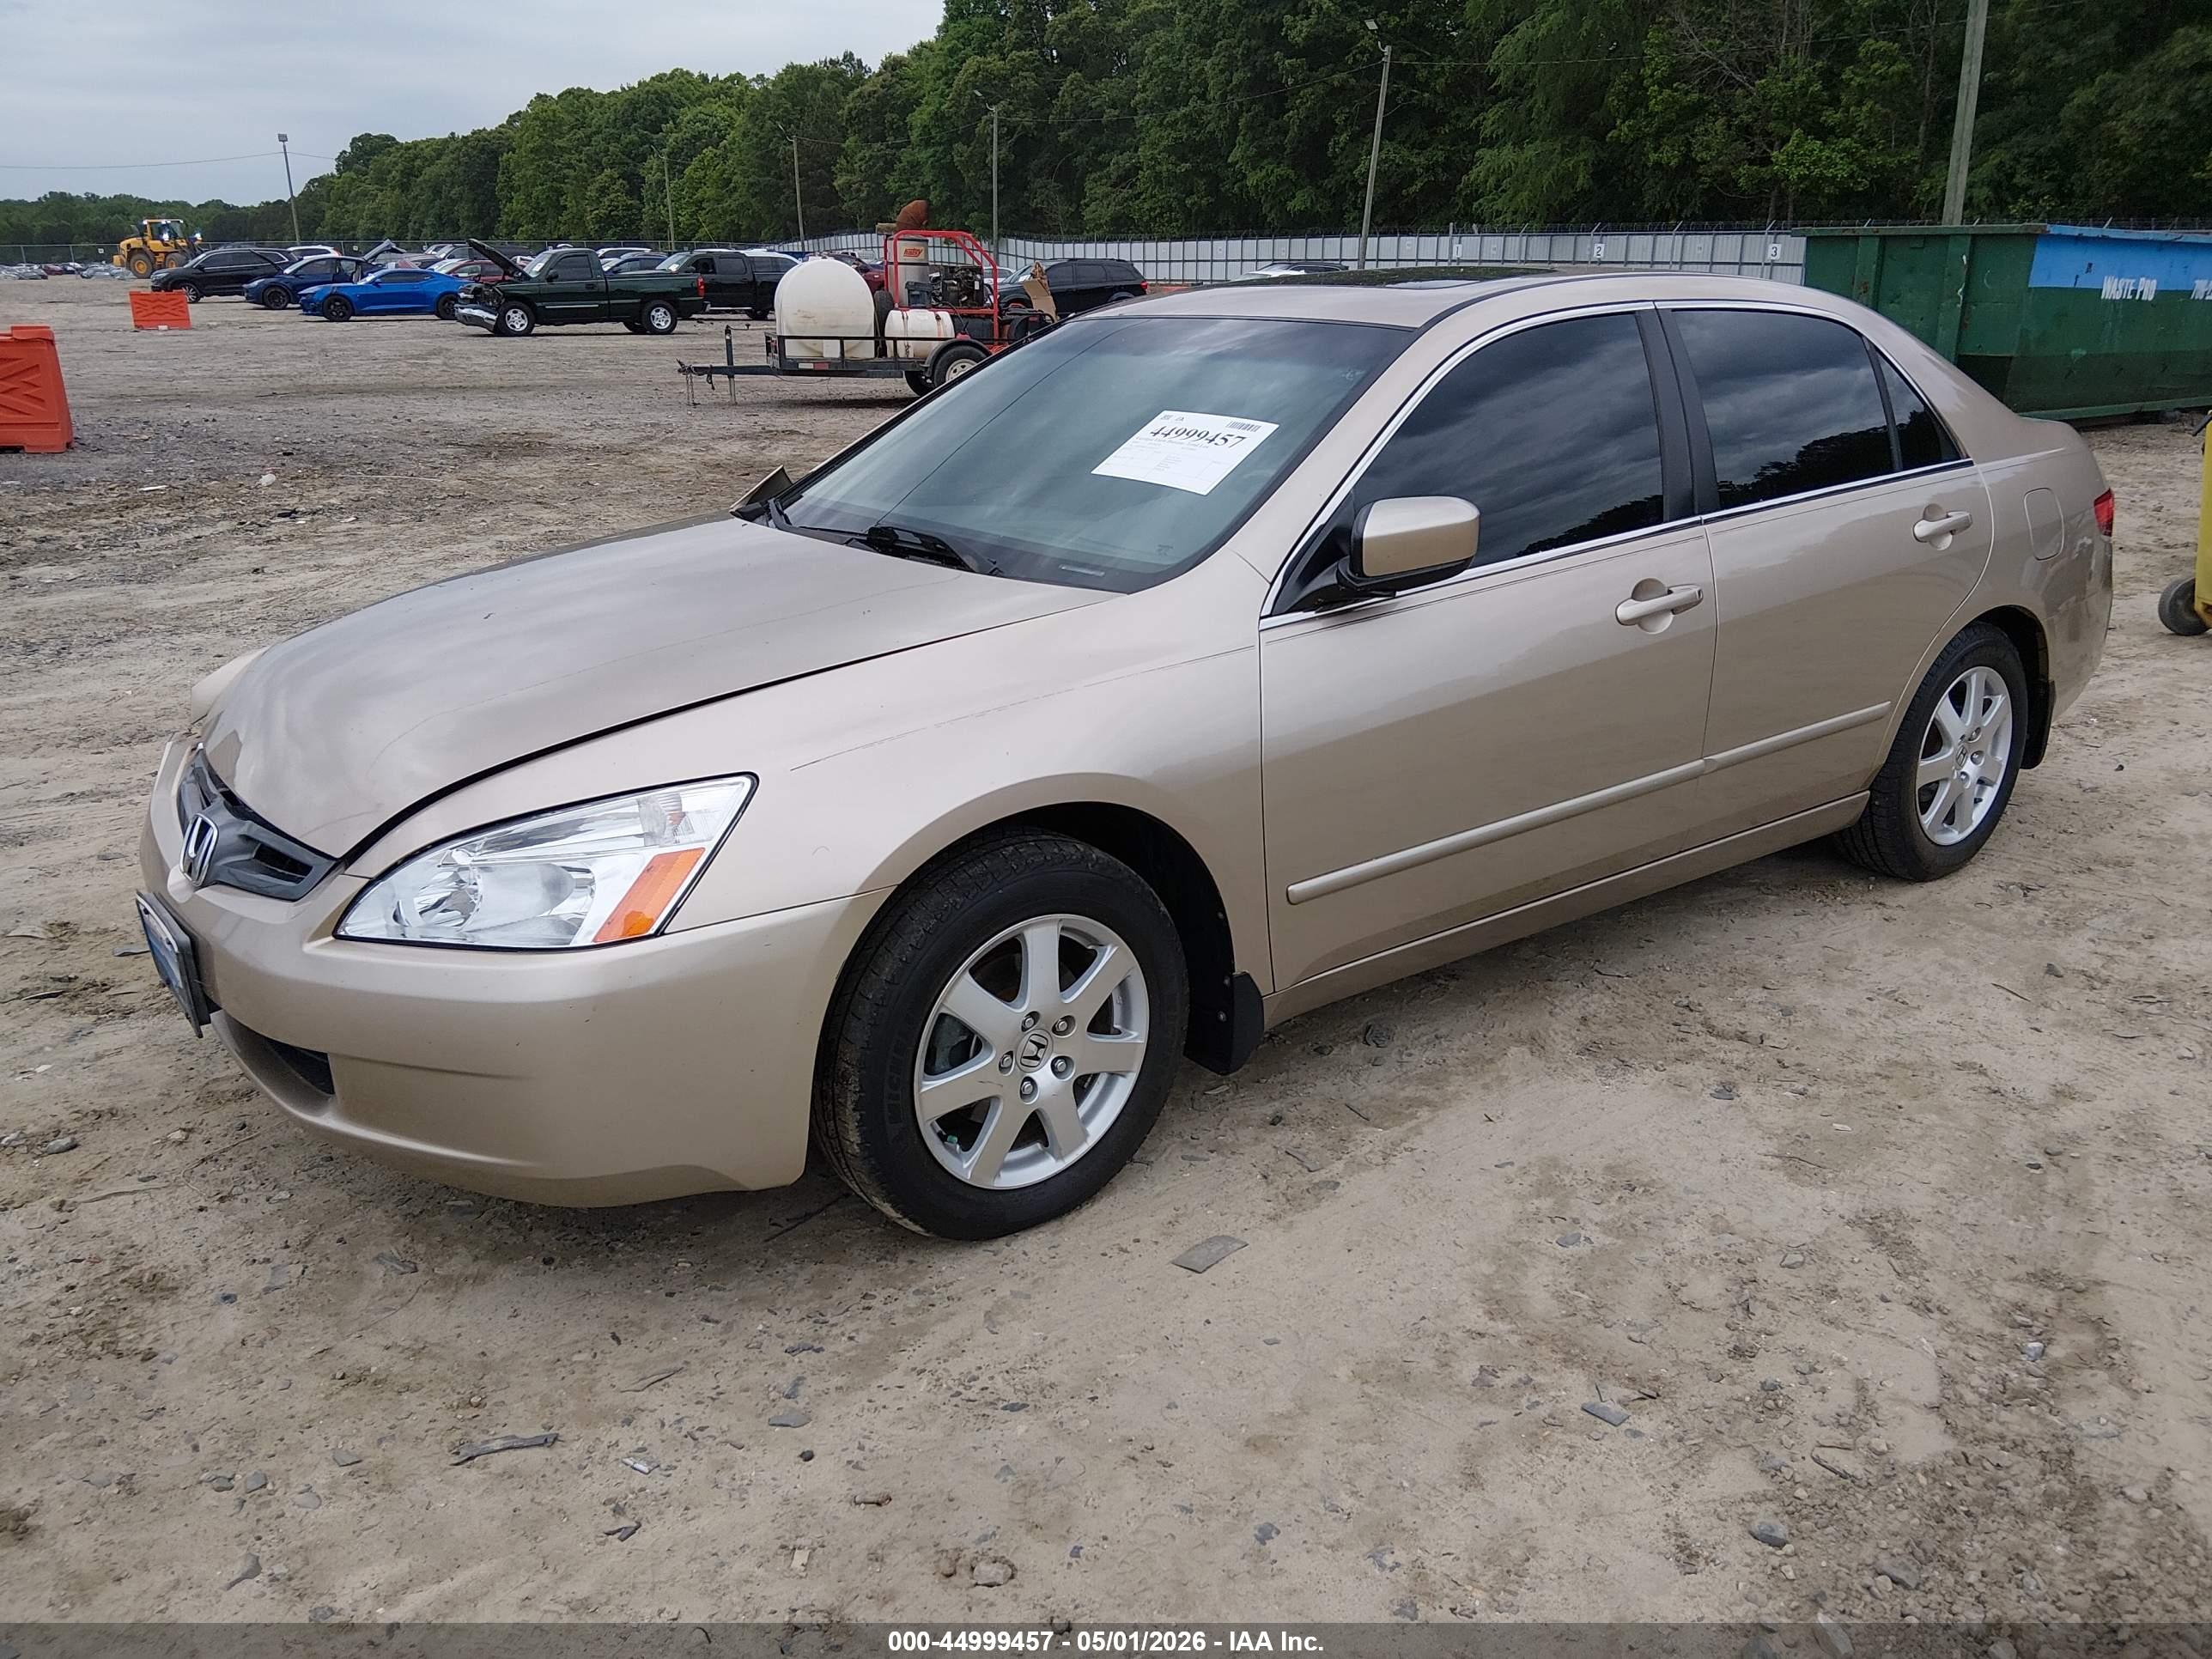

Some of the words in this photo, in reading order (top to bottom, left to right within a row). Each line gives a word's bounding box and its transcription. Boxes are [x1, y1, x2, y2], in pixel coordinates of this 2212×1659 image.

[1596, 246, 1601, 257] 2
[1771, 246, 1778, 257] 3
[2100, 276, 2136, 300] WASTE
[2136, 276, 2158, 301] PRO
[1150, 426, 1247, 447] 44999457
